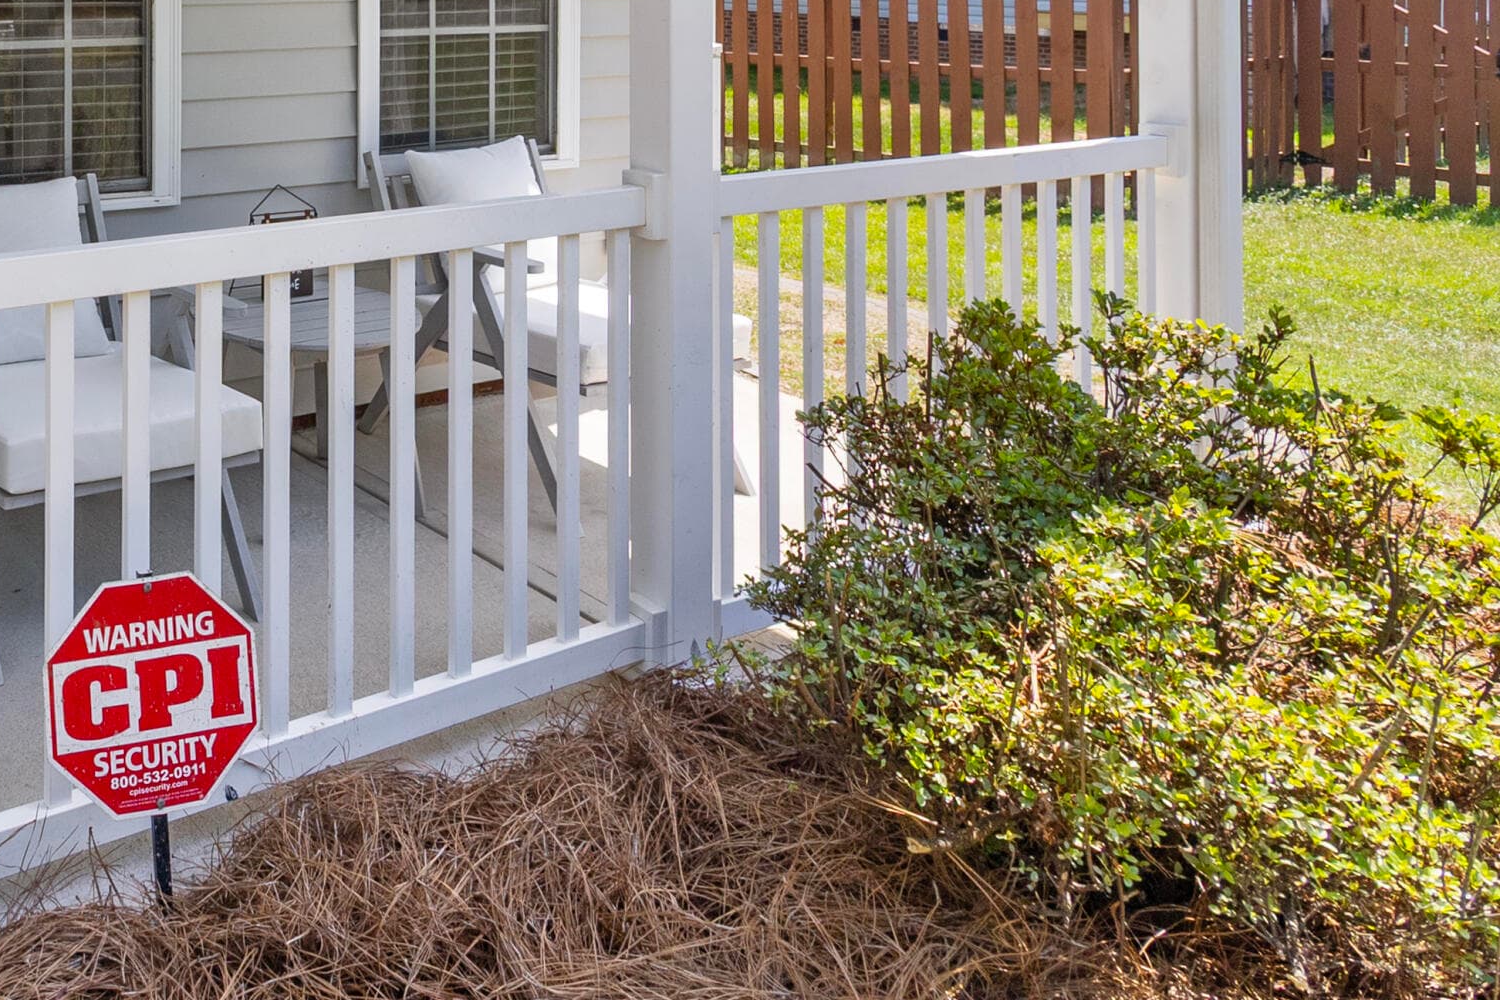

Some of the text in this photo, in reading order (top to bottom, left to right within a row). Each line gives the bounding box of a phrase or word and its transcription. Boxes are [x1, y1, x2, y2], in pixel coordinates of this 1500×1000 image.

[83, 611, 215, 653] WARNING
[62, 644, 244, 741] CPI
[93, 733, 217, 777] SECURITY
[110, 762, 207, 790] 800-532-0911
[129, 780, 188, 797] cpisecurity.com
